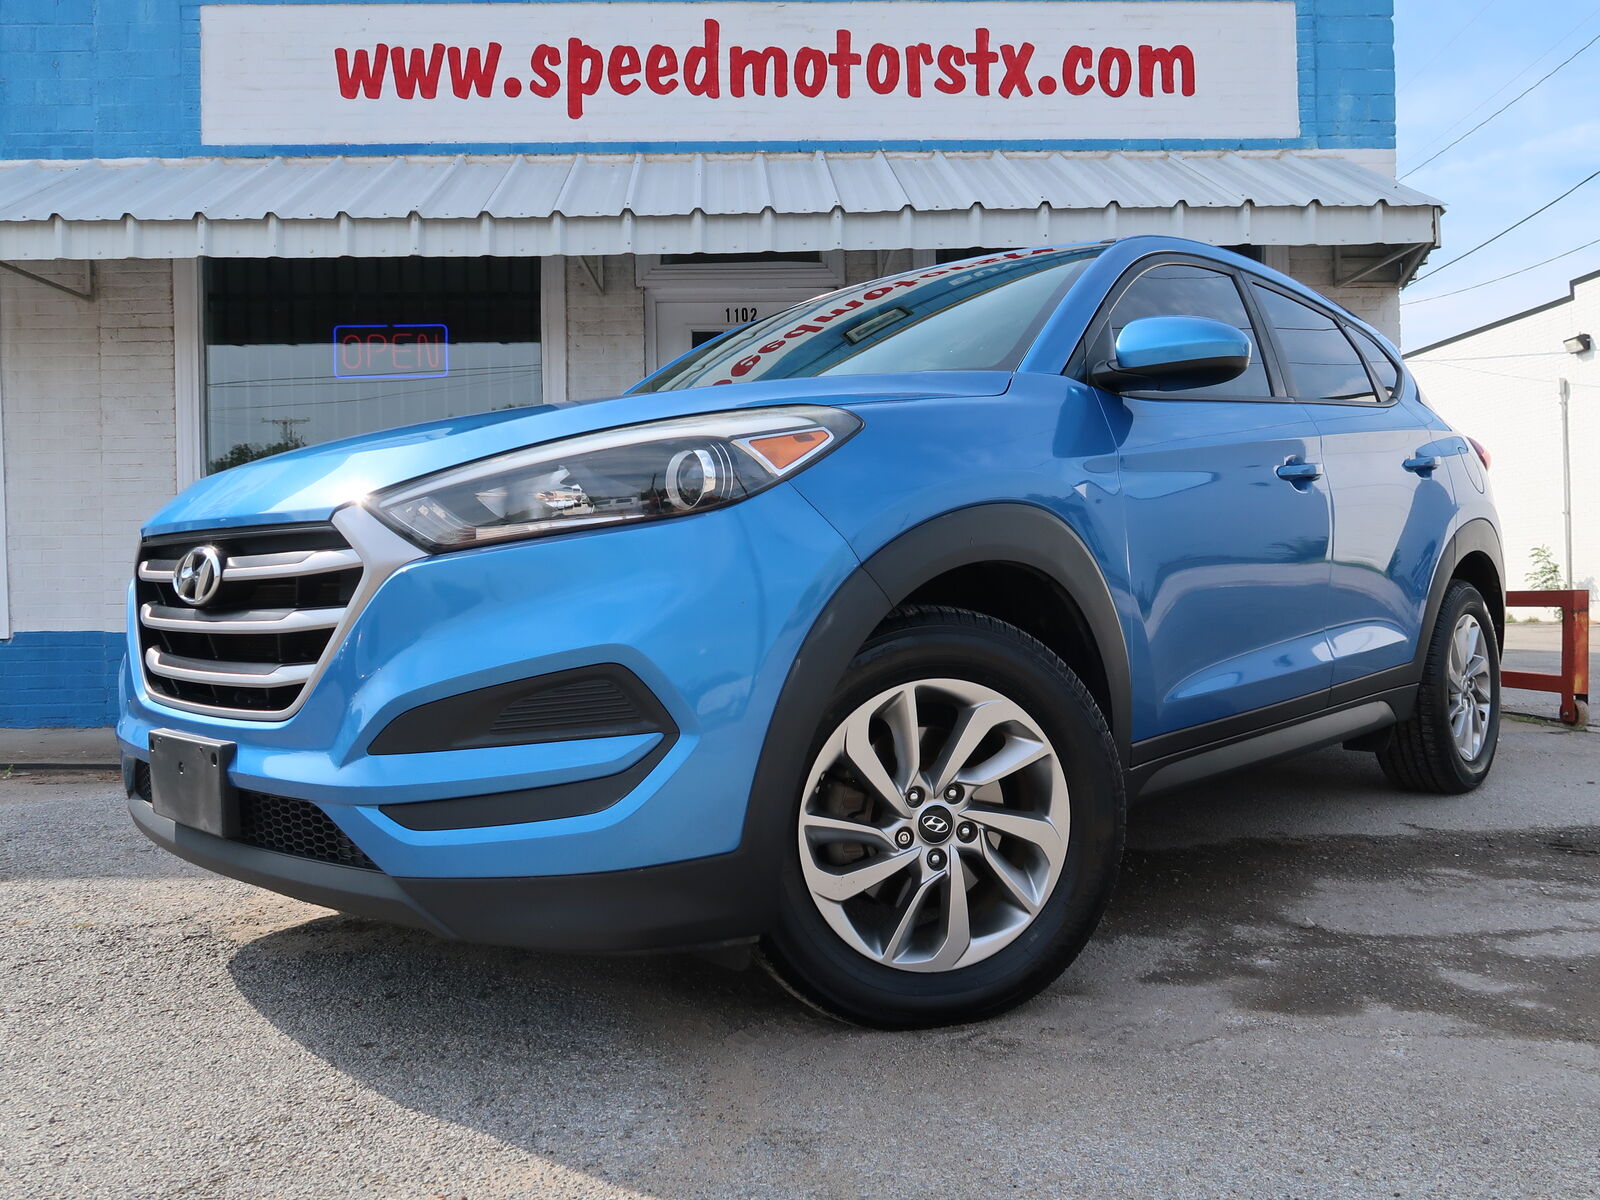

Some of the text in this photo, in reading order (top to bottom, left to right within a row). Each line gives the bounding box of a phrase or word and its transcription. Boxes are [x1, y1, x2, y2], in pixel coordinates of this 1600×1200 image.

[334, 18, 1196, 119] www.speedmotorstx.com
[725, 307, 758, 323] 1102
[342, 332, 440, 369] OPEN
